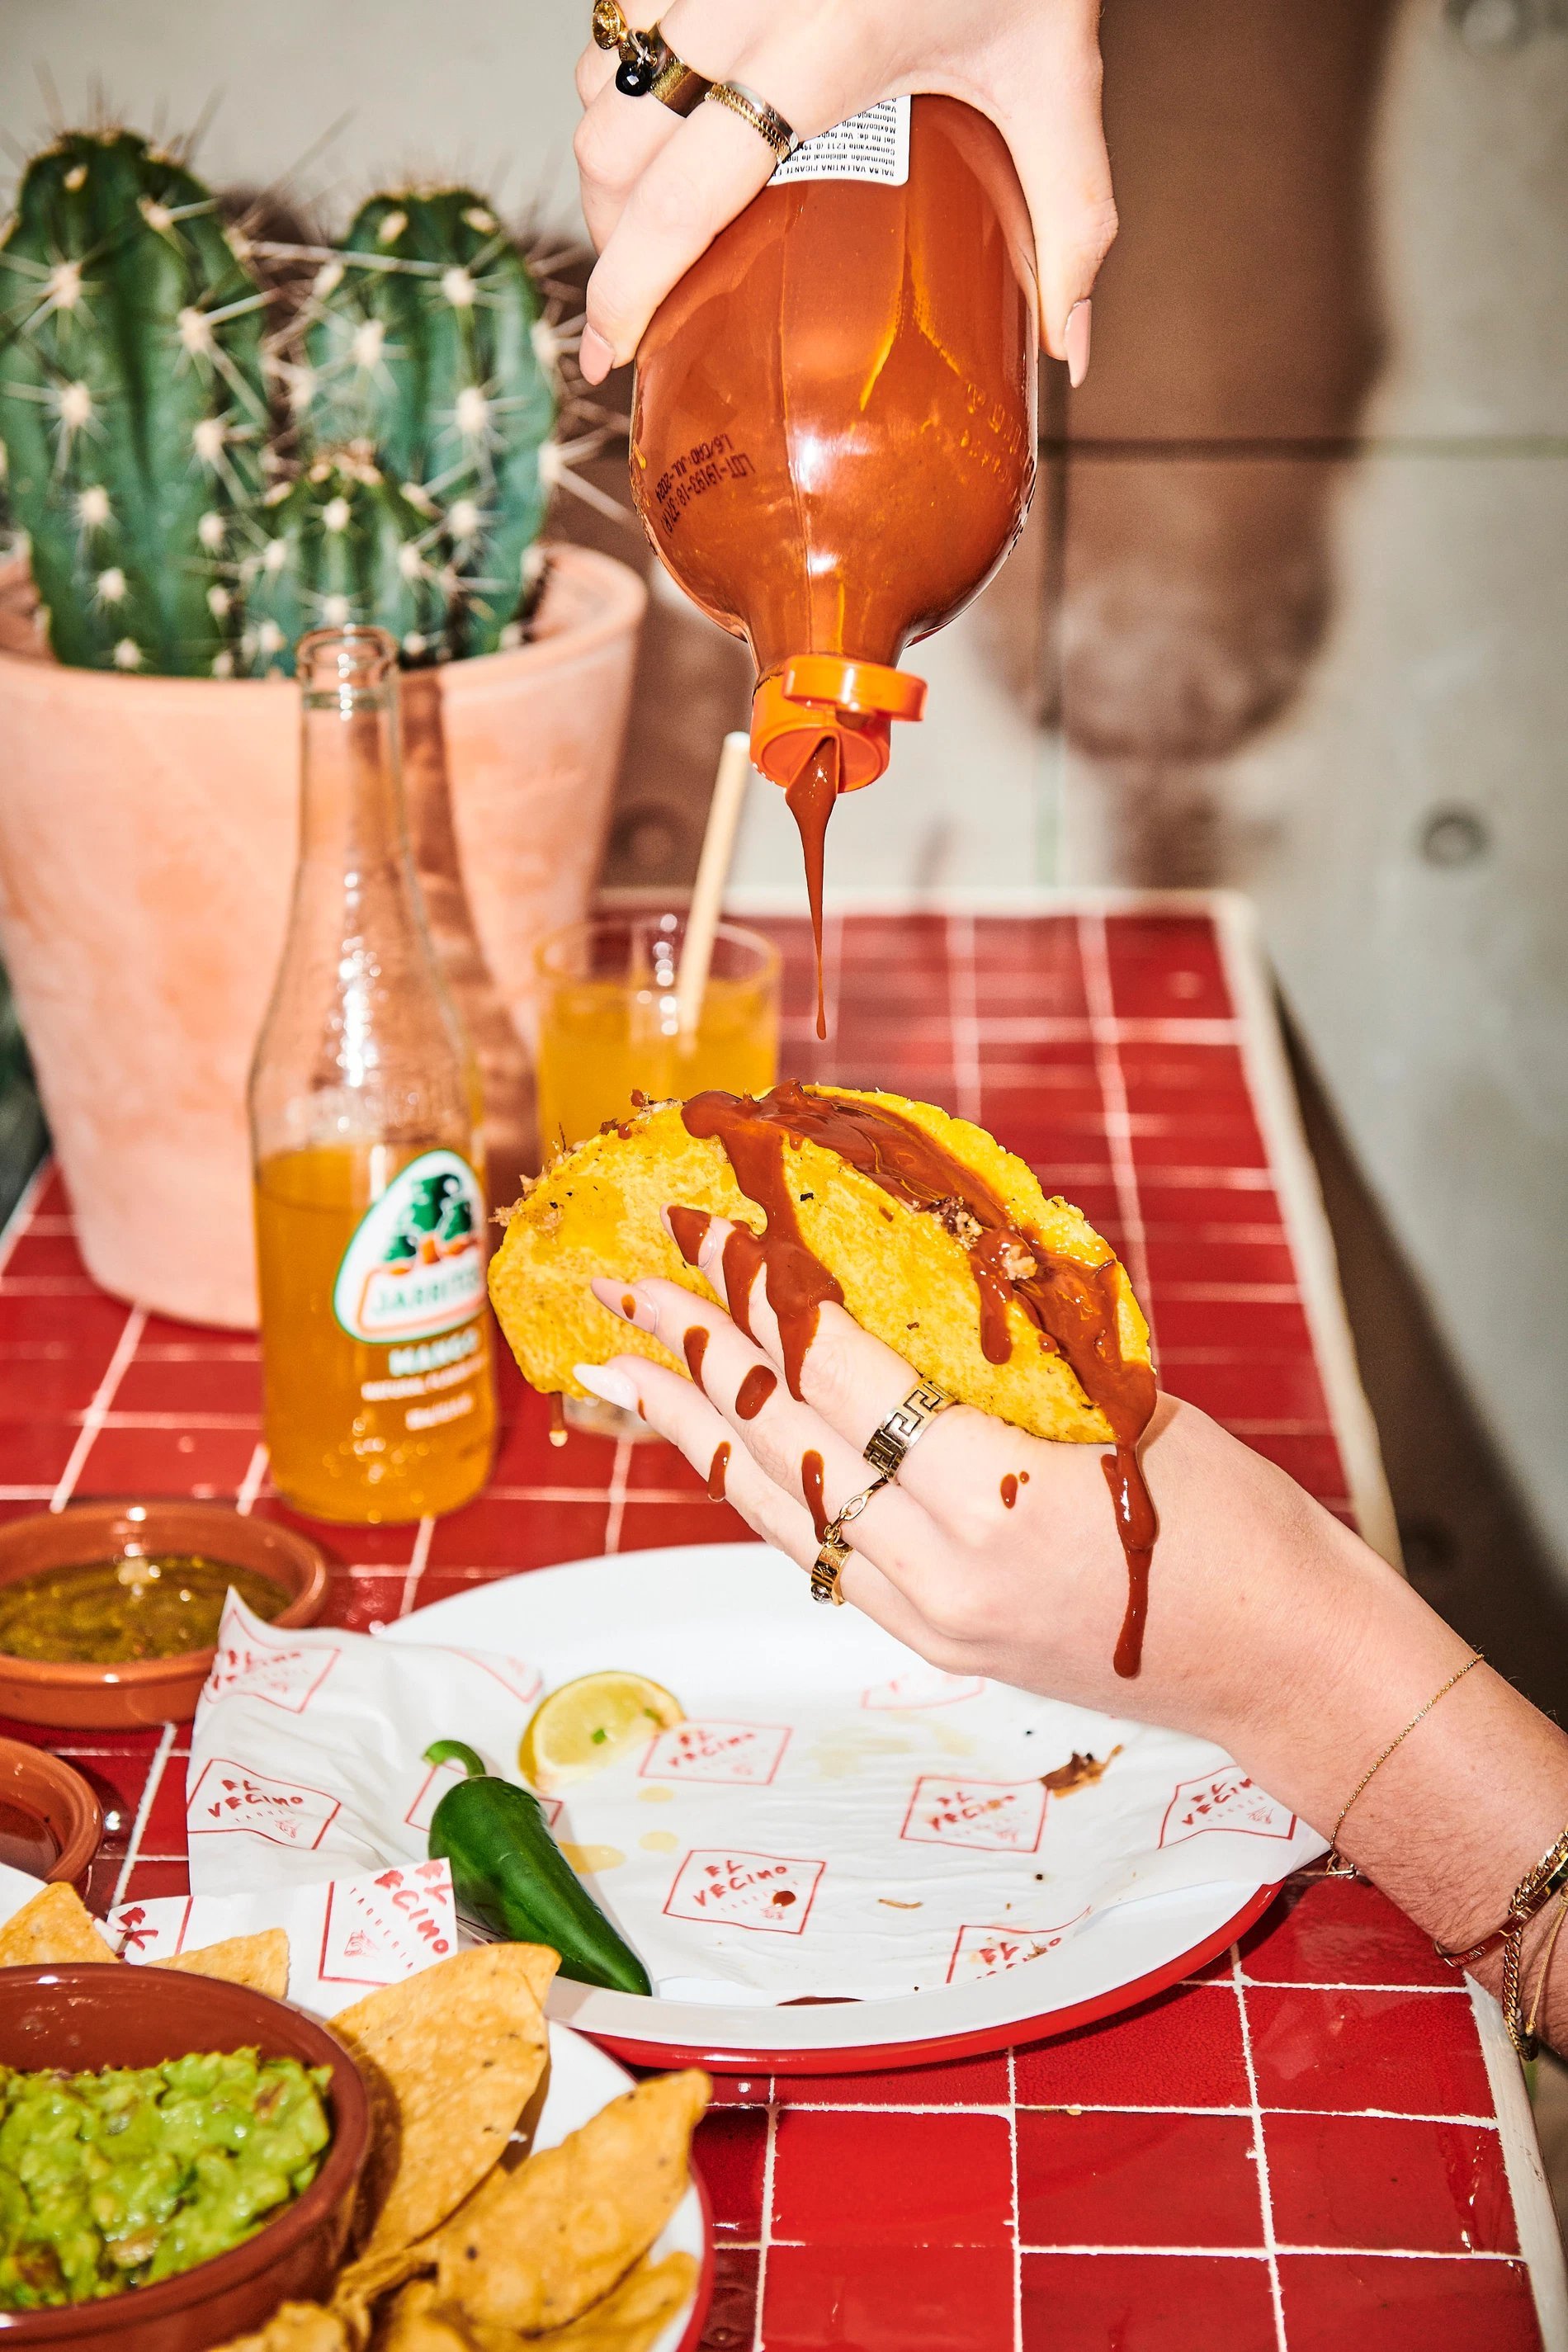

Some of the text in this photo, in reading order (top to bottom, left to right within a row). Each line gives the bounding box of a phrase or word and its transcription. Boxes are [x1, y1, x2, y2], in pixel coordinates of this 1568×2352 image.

[855, 112, 896, 123] Informació
[849, 144, 895, 155] Conservante
[786, 165, 818, 175] PICANTE
[821, 164, 866, 173] VALENTINA
[678, 1731, 714, 1745] EL
[668, 1732, 755, 1768] VECINO
[221, 1778, 262, 1792] EL
[1190, 1782, 1228, 1803] EL
[207, 1792, 304, 1819] VECINO
[937, 1791, 973, 1807] EL
[1182, 1778, 1254, 1825] VECIN
[704, 1858, 744, 1877] EL
[693, 1865, 787, 1907] VECINO
[374, 1869, 450, 1955] ECINO
[979, 1941, 1020, 1965] EL
